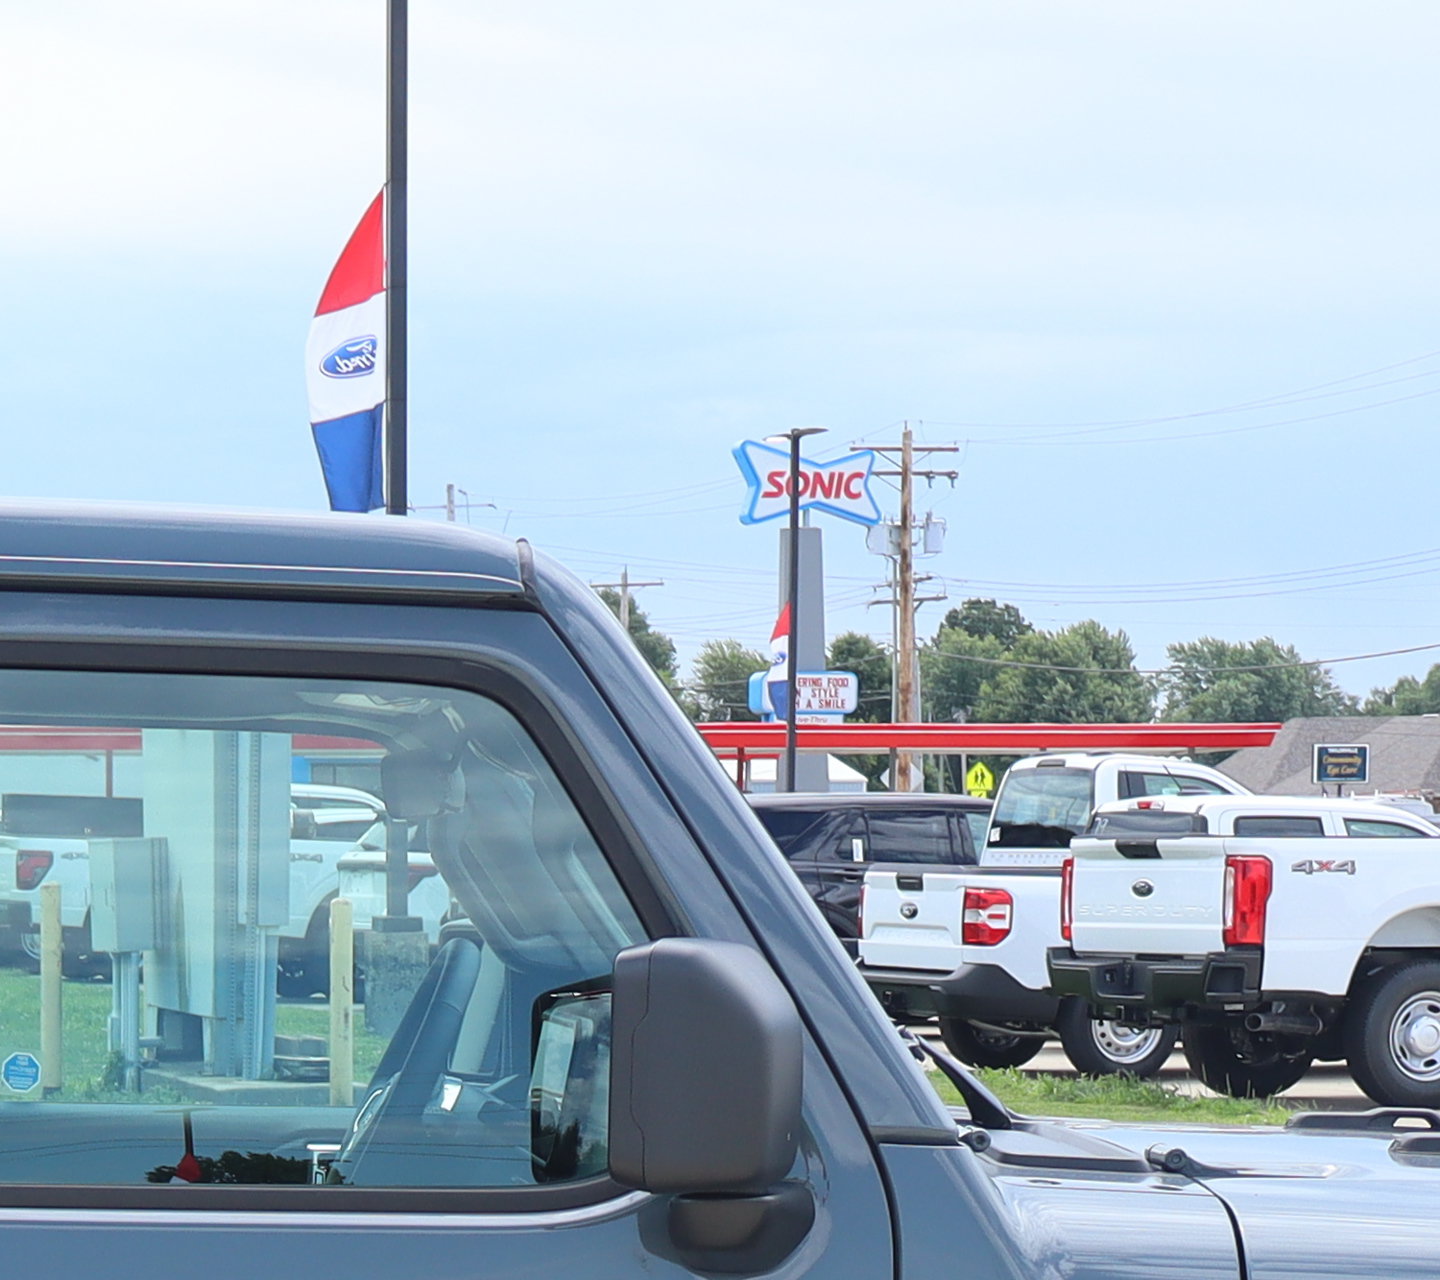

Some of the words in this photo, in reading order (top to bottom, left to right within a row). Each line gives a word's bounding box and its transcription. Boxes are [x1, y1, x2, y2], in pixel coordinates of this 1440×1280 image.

[761, 470, 865, 500] SONIC
[827, 677, 849, 688] FOOD
[1079, 904, 1148, 917] SUPER
[1153, 905, 1214, 918] DUTY
